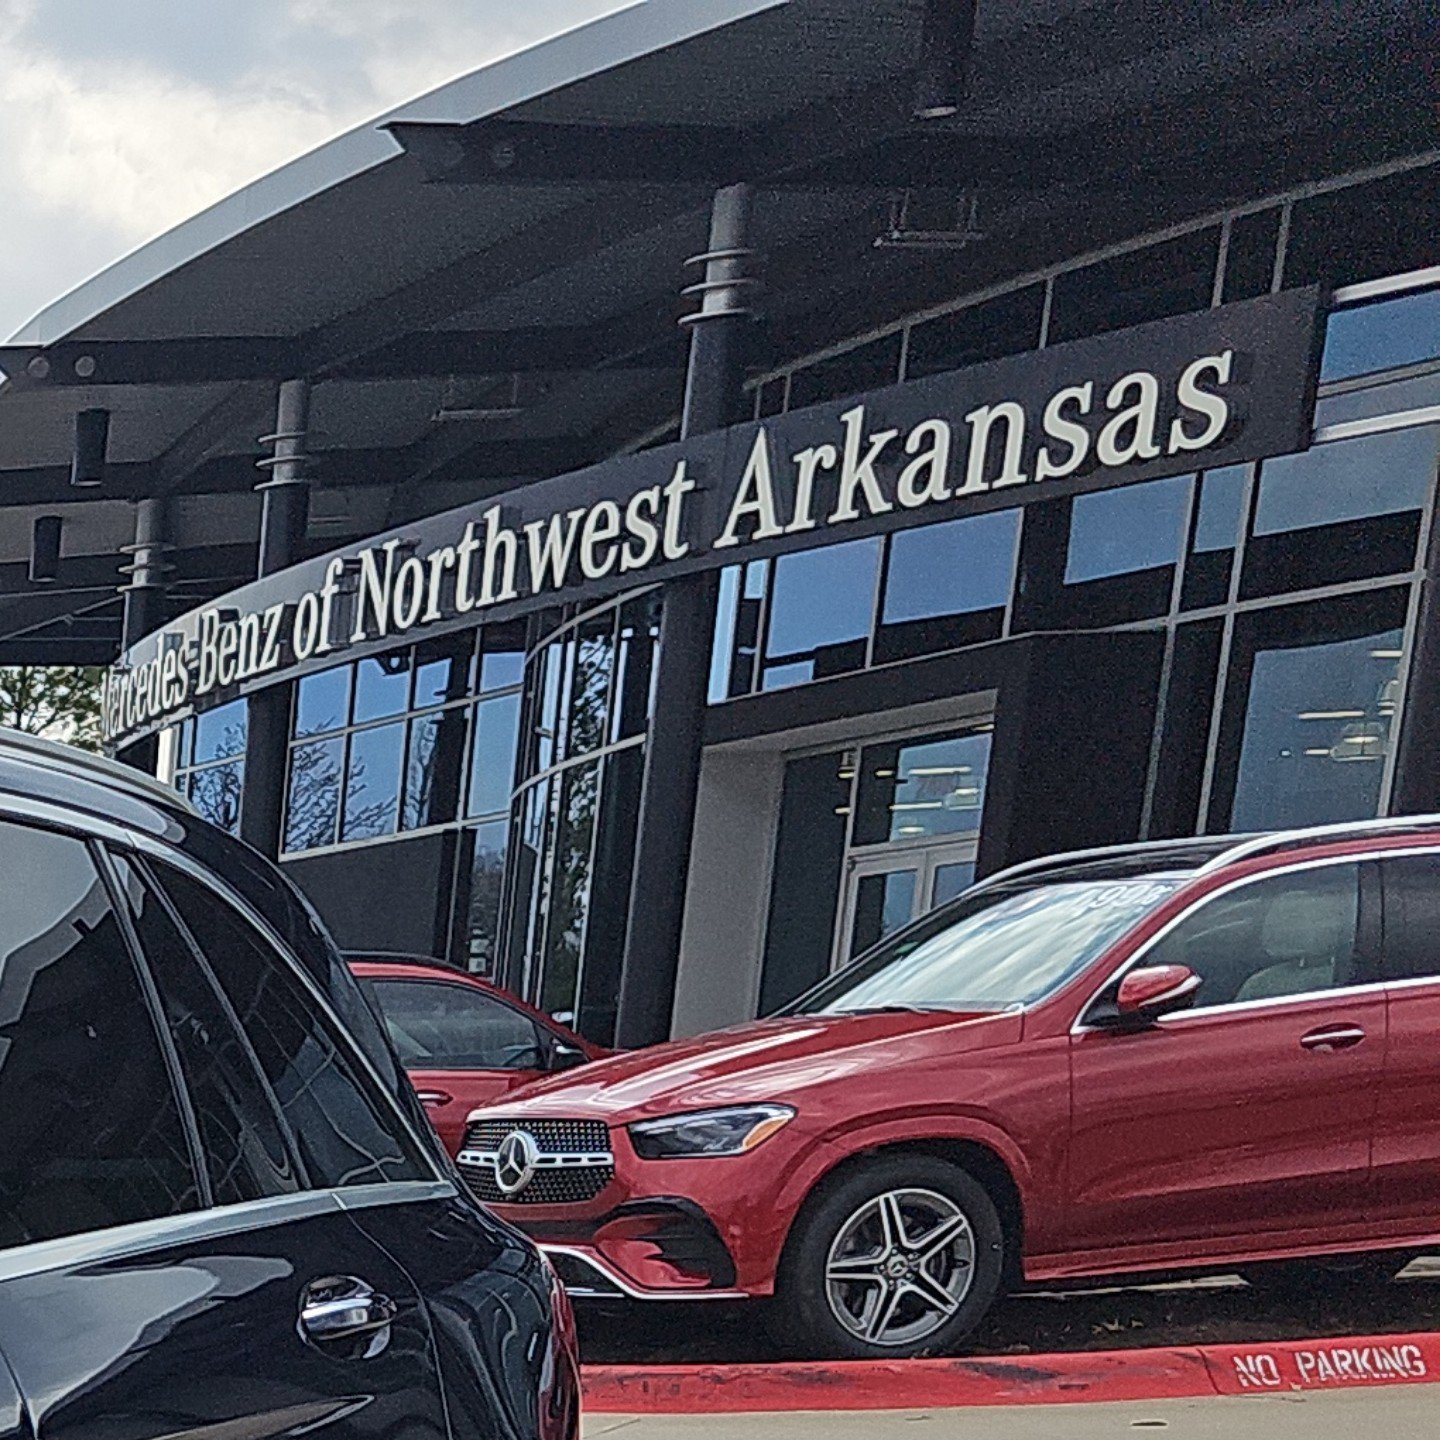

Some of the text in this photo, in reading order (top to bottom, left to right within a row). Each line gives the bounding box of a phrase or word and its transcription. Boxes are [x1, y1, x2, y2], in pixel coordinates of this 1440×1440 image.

[293, 557, 343, 660] of
[350, 459, 697, 642] Northwest
[713, 348, 1234, 549] Arkansas
[1233, 1344, 1427, 1388] NO PARKING
